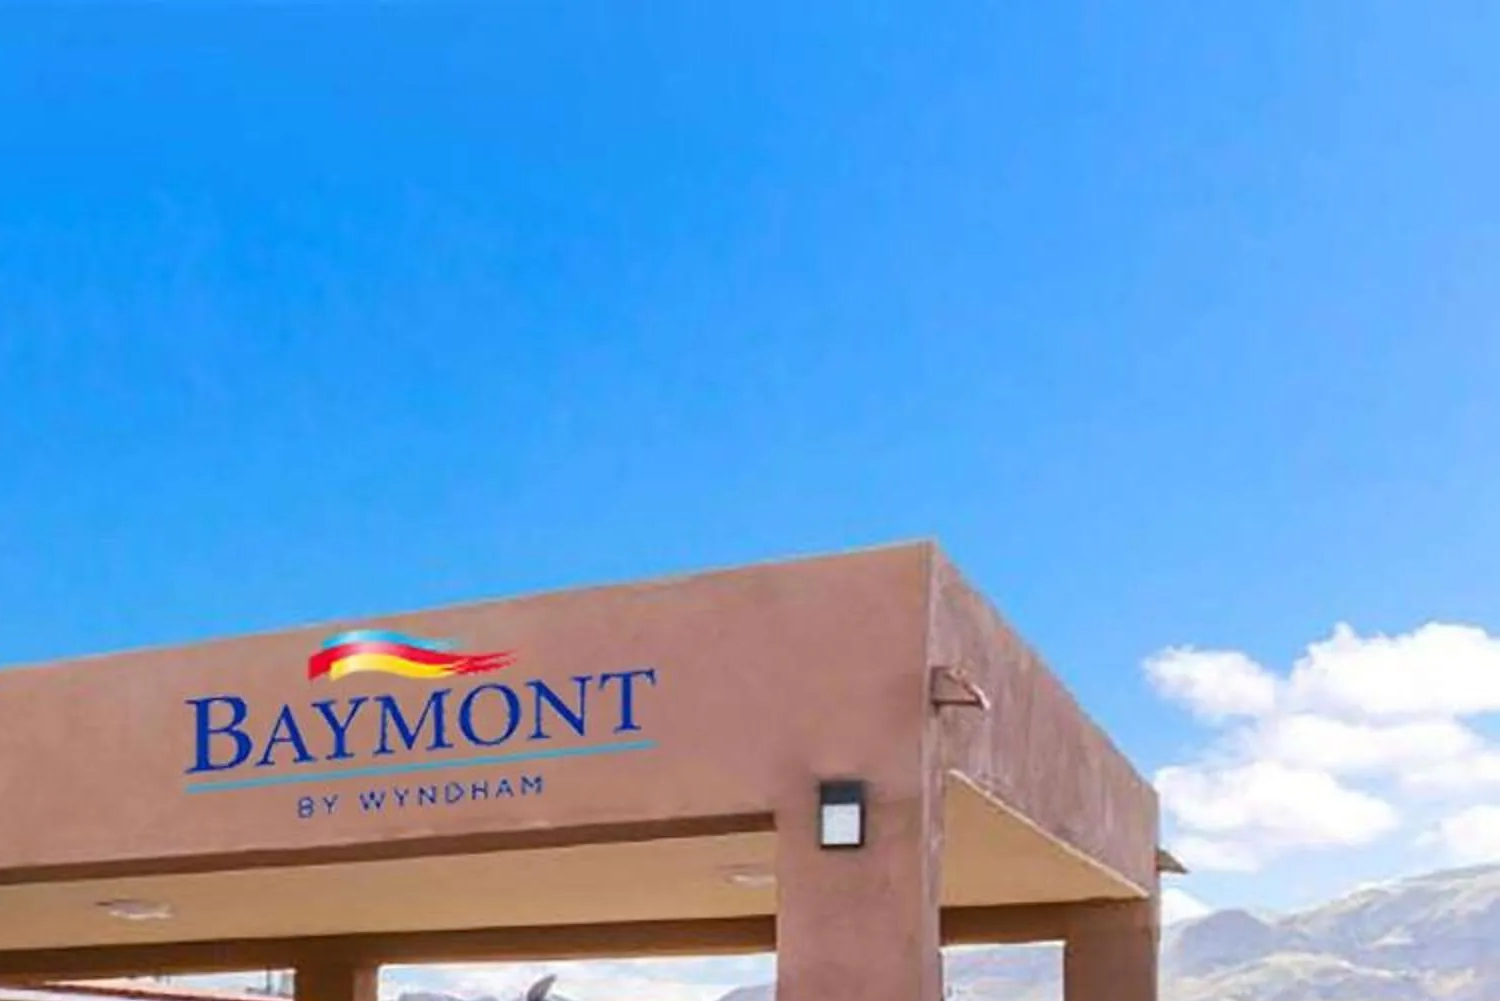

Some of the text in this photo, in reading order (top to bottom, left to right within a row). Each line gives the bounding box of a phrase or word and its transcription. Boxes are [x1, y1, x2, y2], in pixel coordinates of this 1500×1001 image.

[184, 668, 657, 775] BAYMONT
[297, 775, 545, 819] BY WYNDHAM
